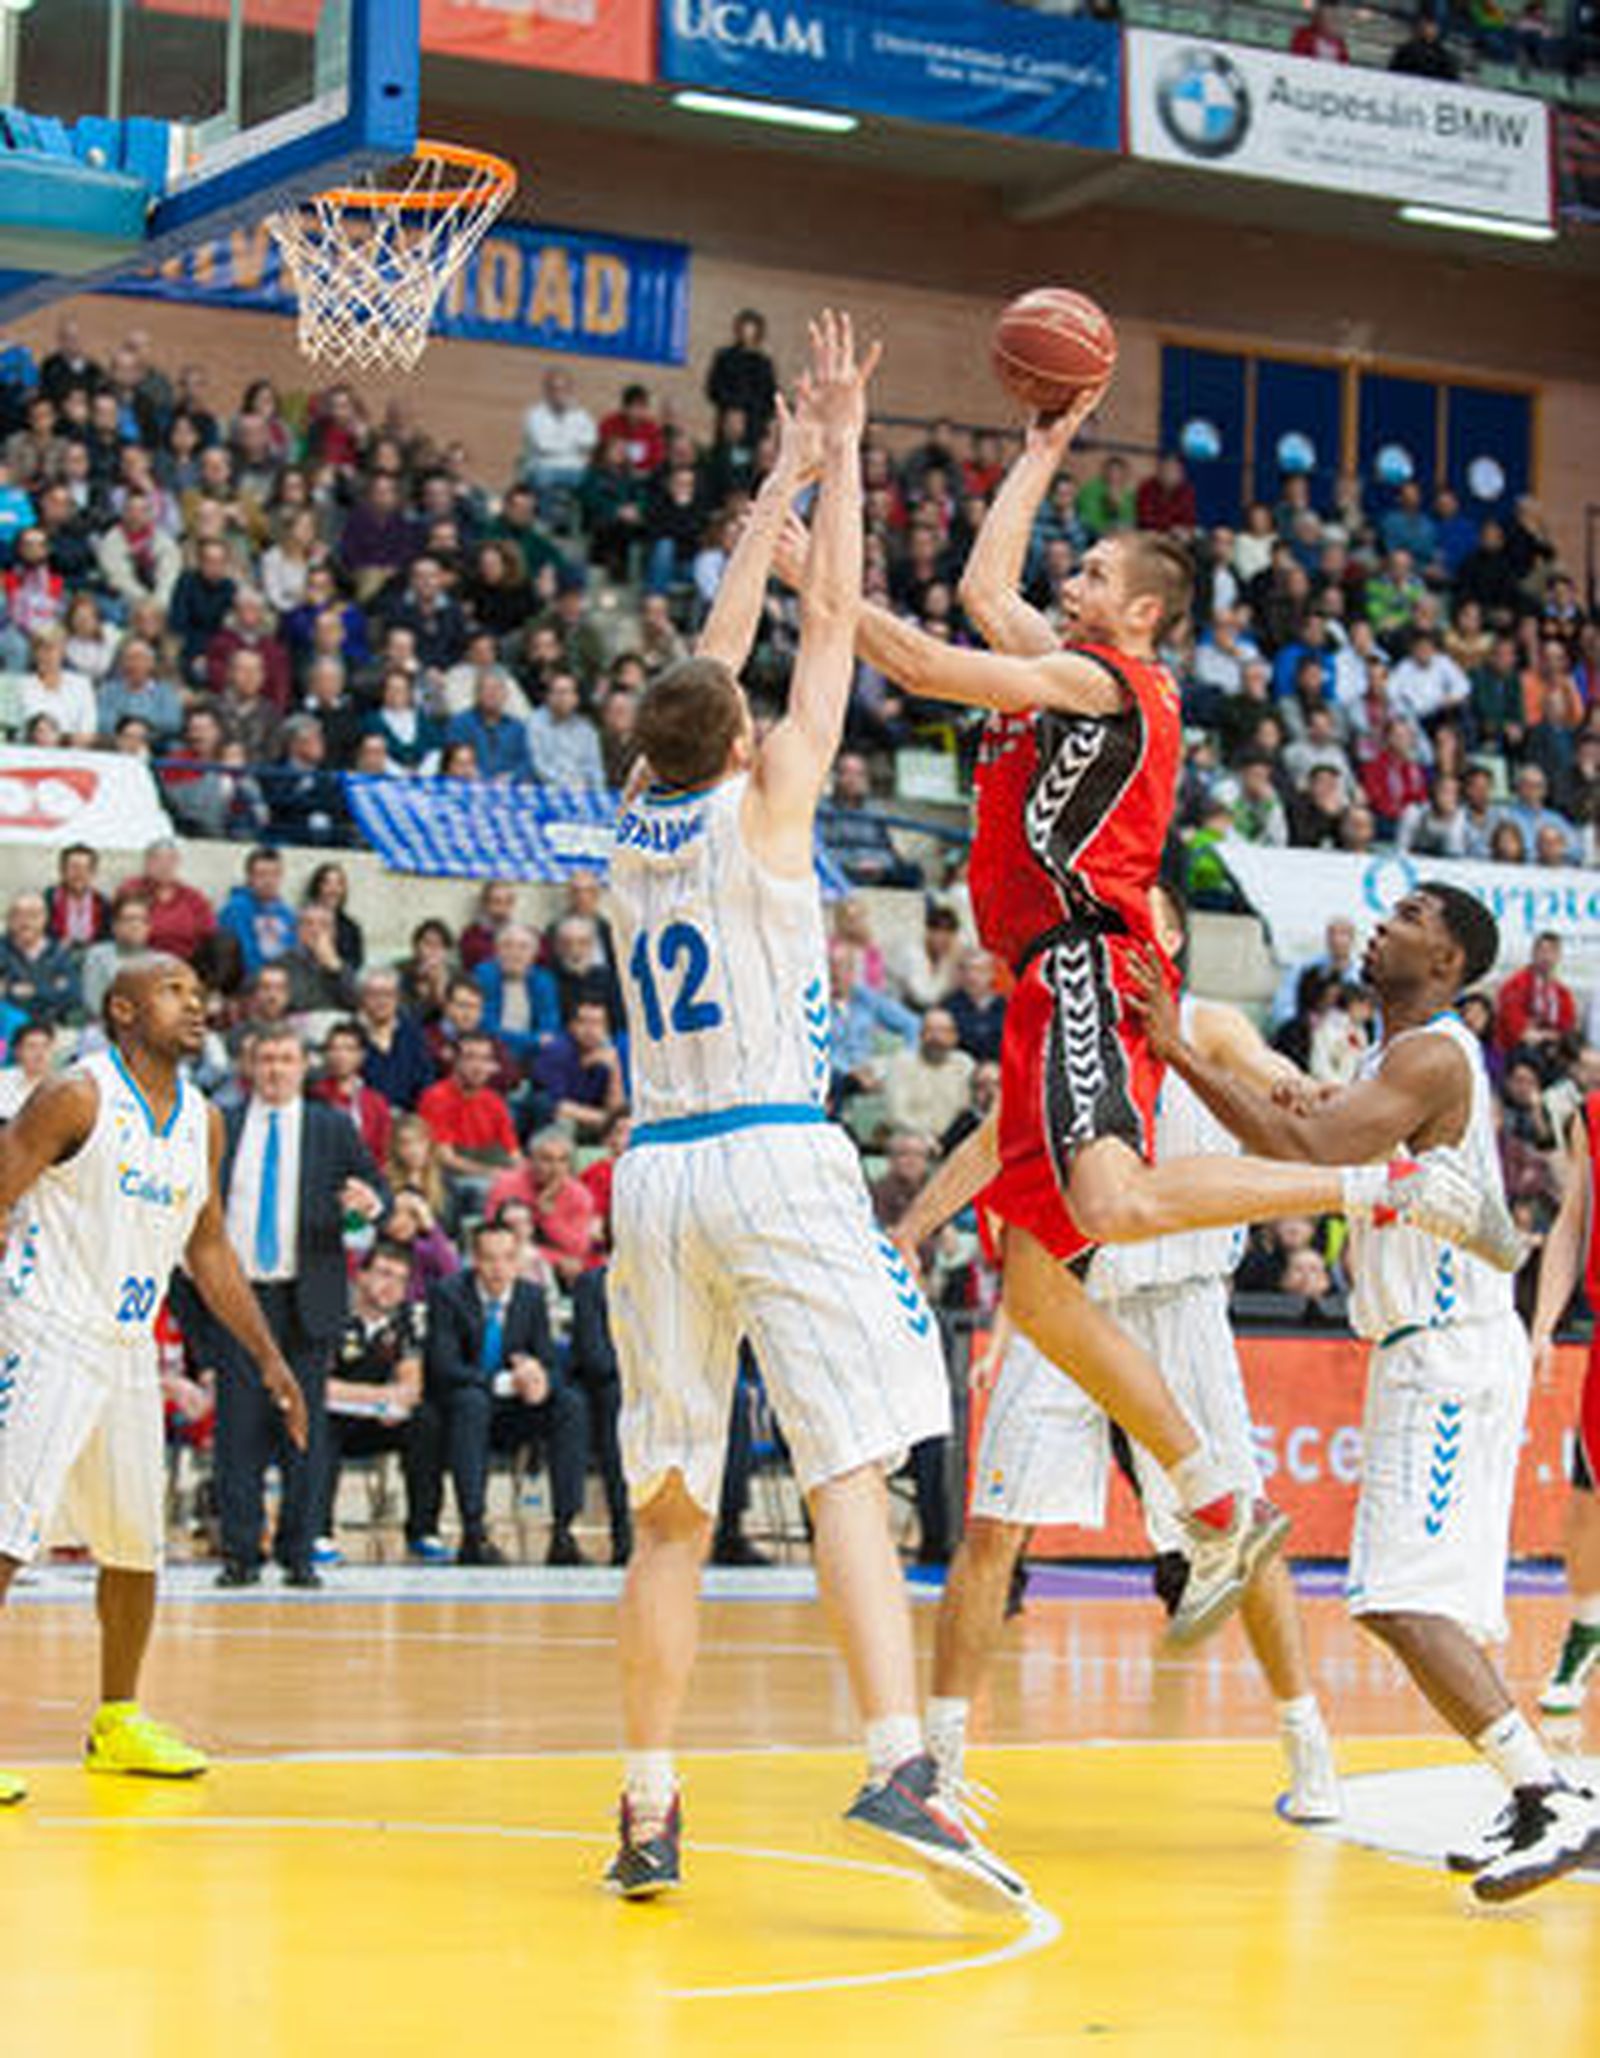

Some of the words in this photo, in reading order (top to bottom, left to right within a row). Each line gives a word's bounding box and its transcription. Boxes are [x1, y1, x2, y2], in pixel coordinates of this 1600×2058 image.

[672, 0, 826, 60] UCAM
[1434, 103, 1529, 148] BMW
[630, 921, 723, 1042] 12
[116, 1275, 156, 1323] 20
